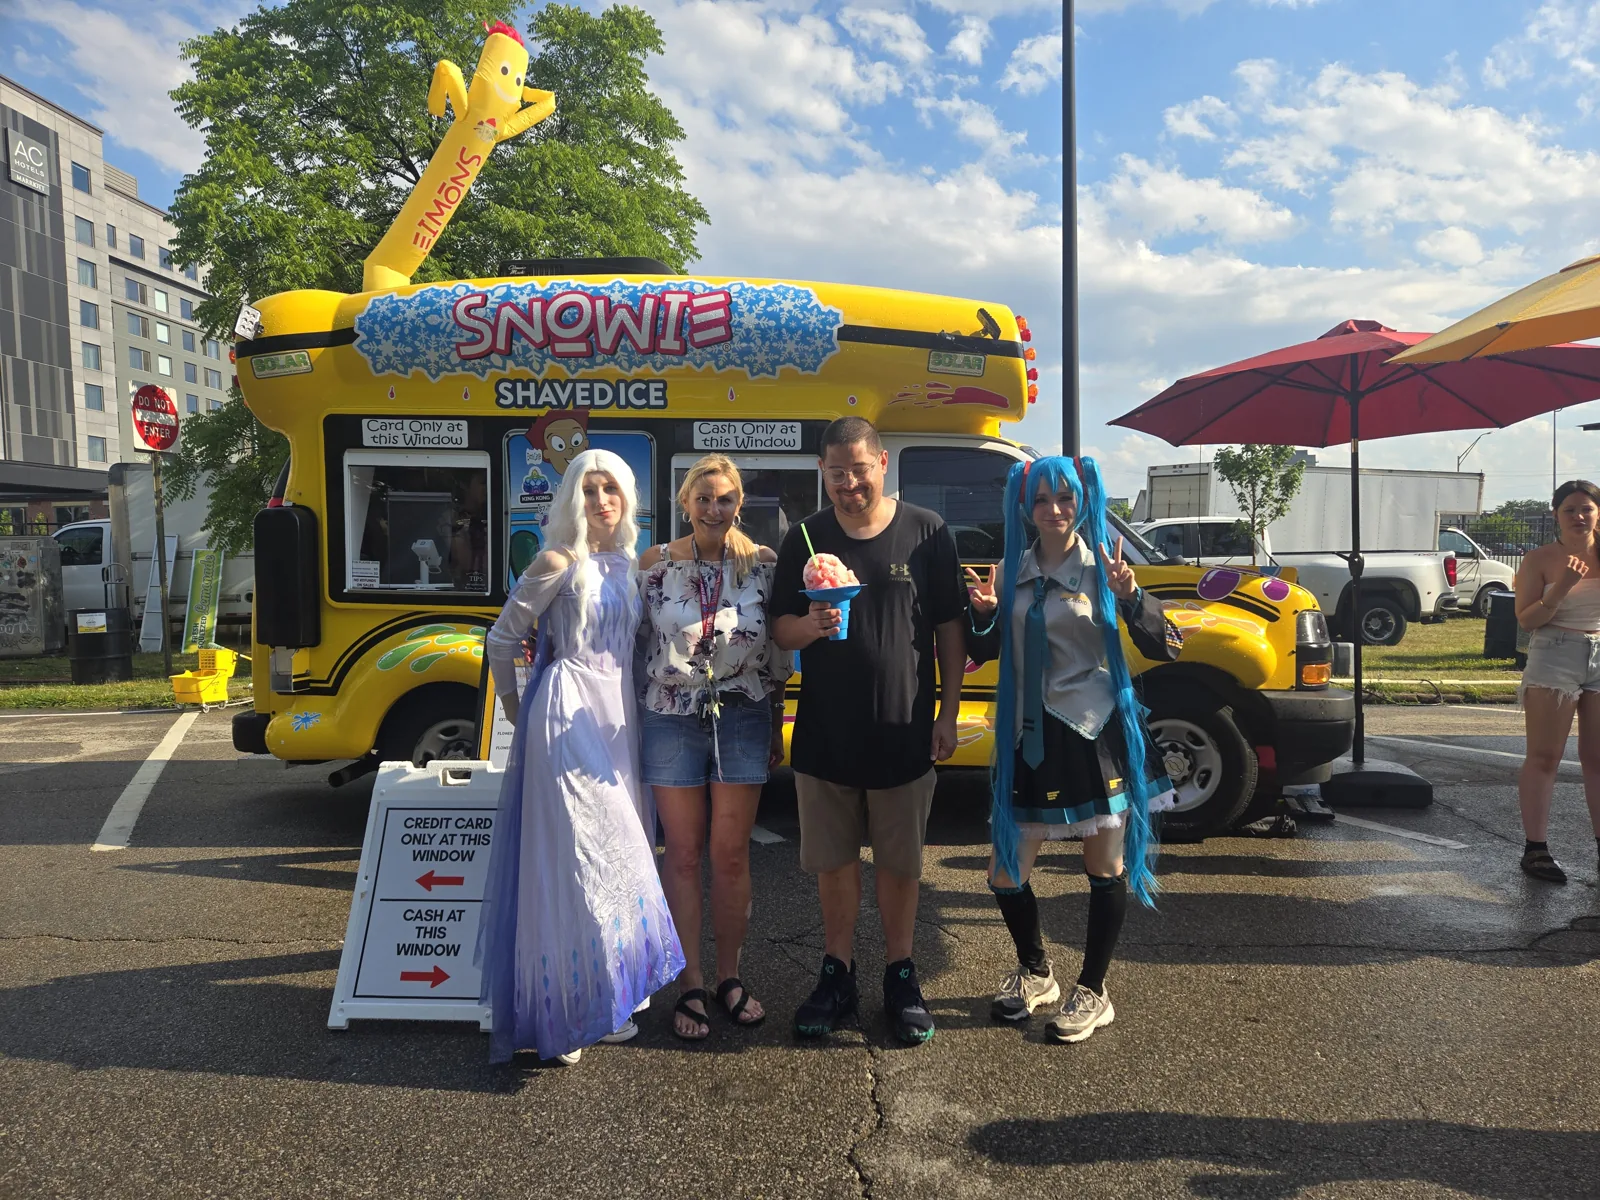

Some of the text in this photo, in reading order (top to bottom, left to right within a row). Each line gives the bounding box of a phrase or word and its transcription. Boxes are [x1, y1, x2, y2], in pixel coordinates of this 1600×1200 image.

[14, 140, 43, 167] AC
[14, 159, 45, 177] HOTELS
[16, 174, 46, 192] MARRIOTT
[412, 146, 482, 250] SNOWIE
[453, 291, 733, 359] SNOWIE
[253, 353, 309, 372] SOLAR
[931, 352, 983, 370] SOLAR
[498, 381, 665, 407] SHAVED ICE
[138, 395, 171, 411] DO NOT
[144, 425, 171, 439] ENTER
[366, 419, 463, 433] Card Only at
[698, 422, 796, 435] Cash Only at
[370, 433, 463, 446] this Window
[701, 436, 796, 449] this Window
[194, 554, 216, 617] Lemonade
[192, 622, 200, 643] FRESH
[198, 616, 207, 649] SQUEEZED
[403, 817, 493, 830] CREDIT CARD
[400, 833, 491, 846] ONLY AT THIS
[412, 849, 475, 862] WINDOW
[403, 908, 466, 922] CASH AT
[415, 926, 447, 939] THIS
[396, 943, 461, 957] WINDOW
